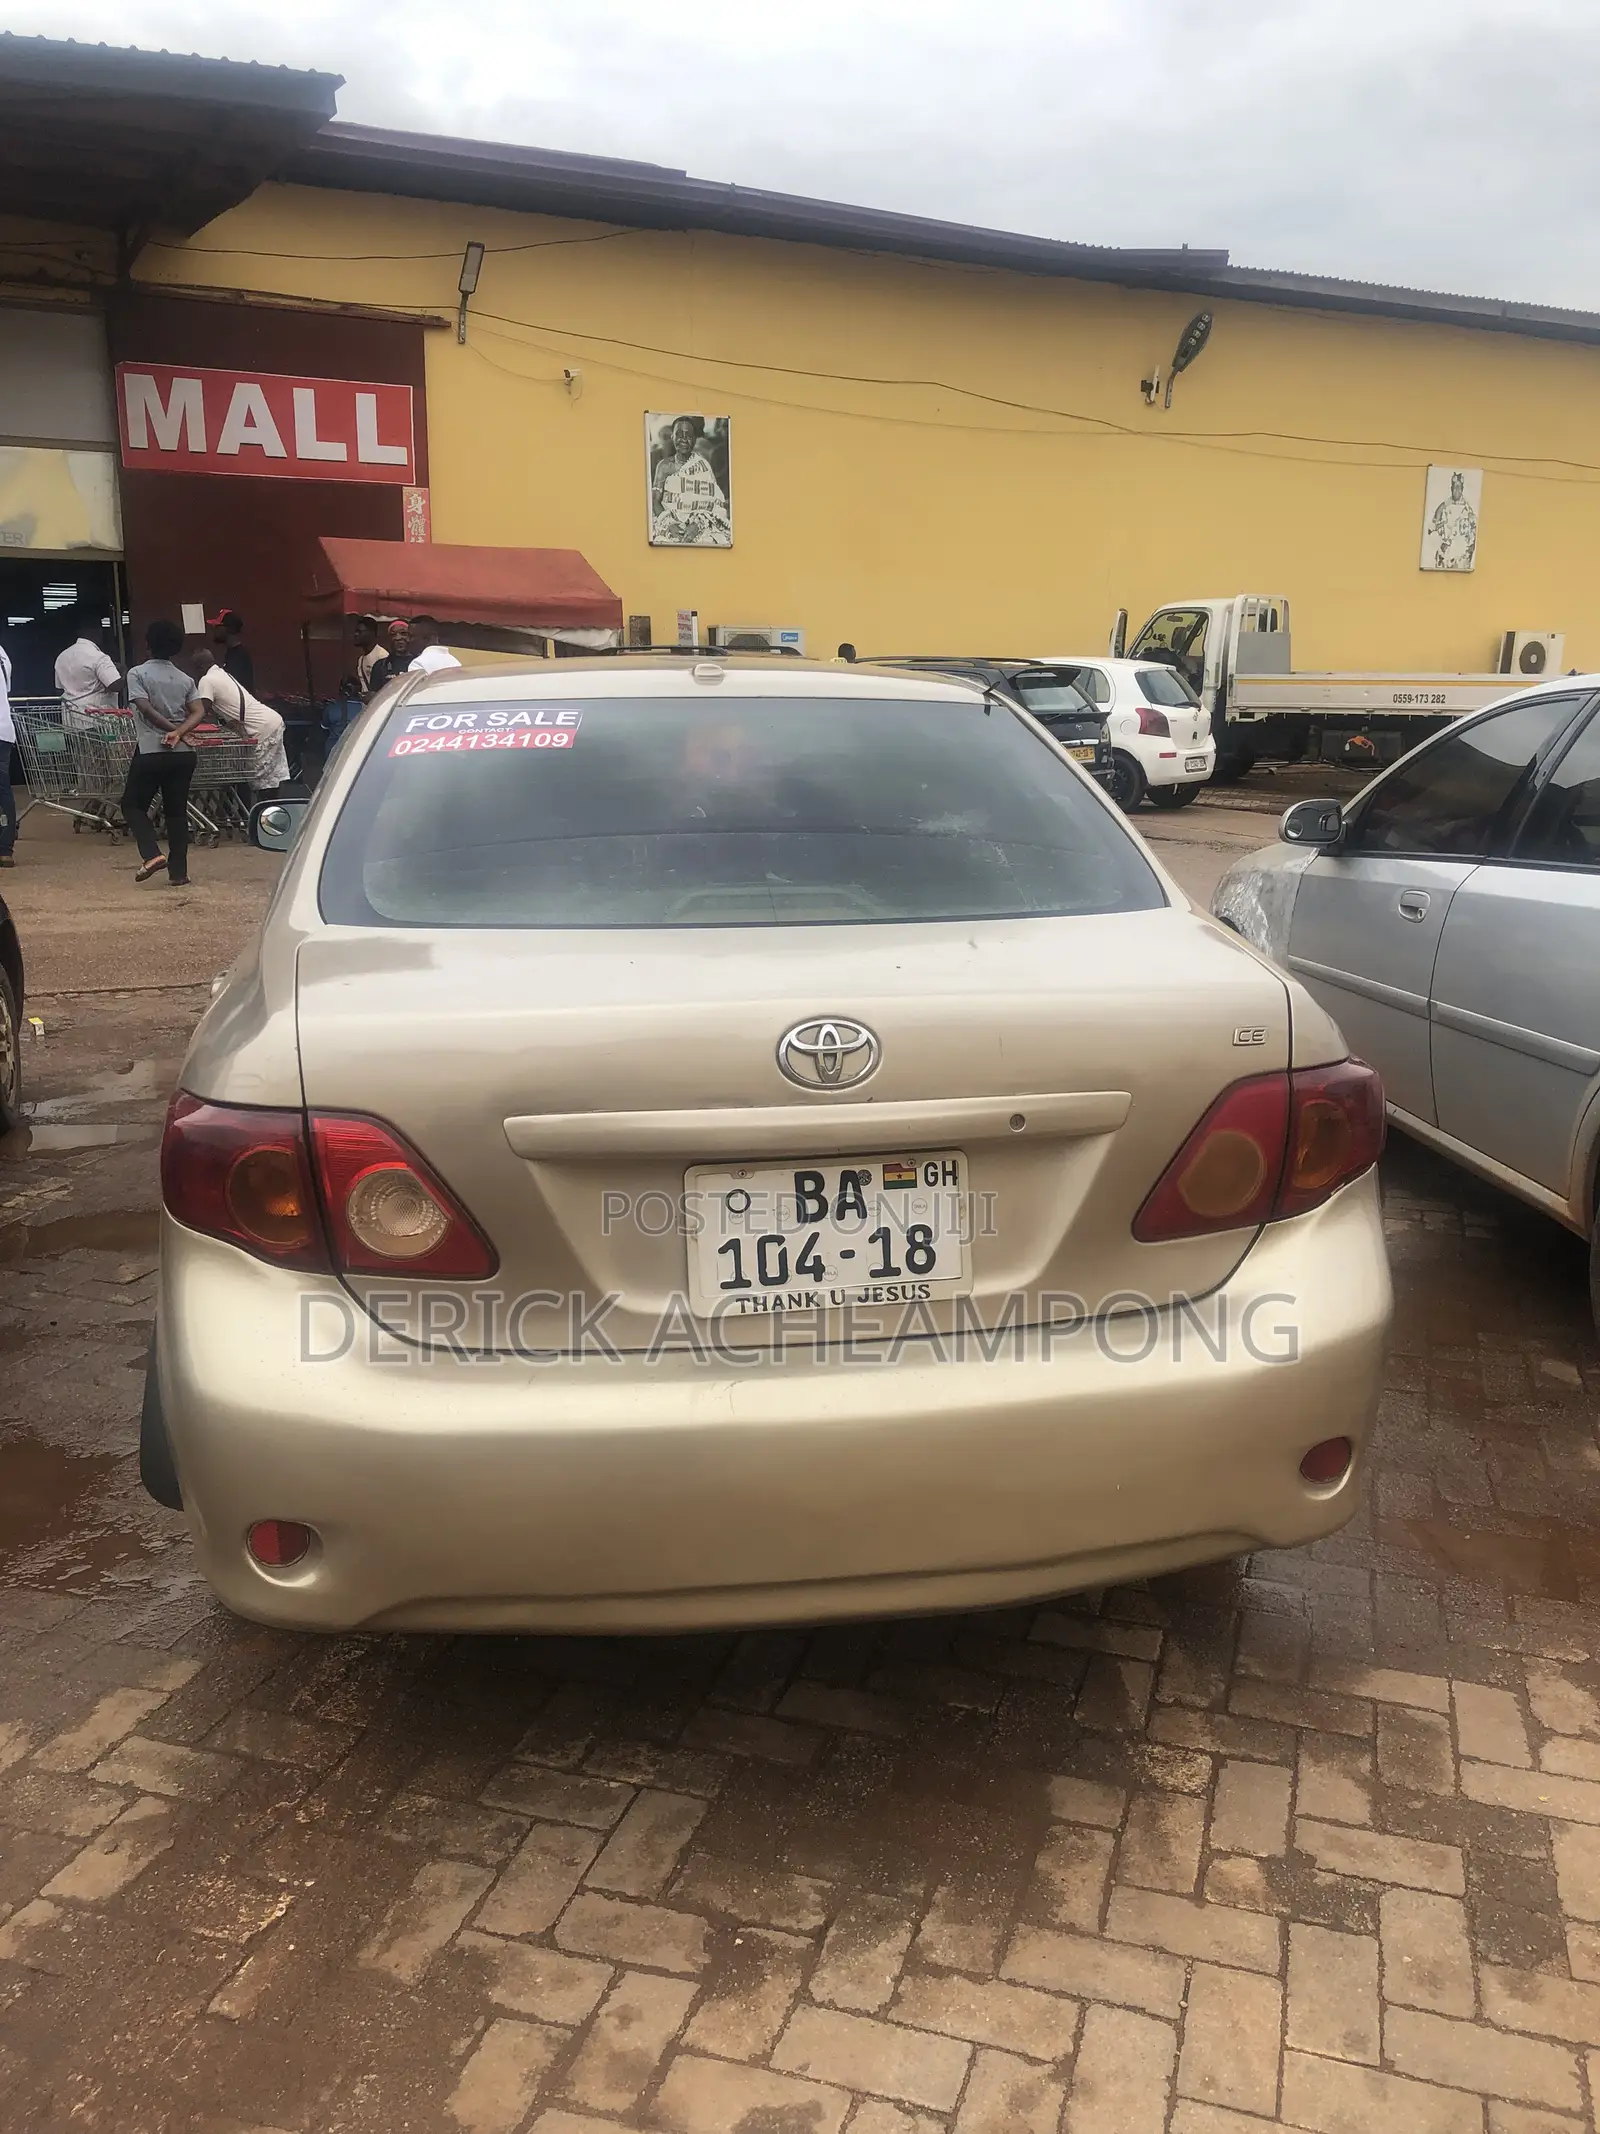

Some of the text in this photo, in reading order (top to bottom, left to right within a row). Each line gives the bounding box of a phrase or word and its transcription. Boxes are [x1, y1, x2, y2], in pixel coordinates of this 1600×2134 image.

[123, 373, 408, 466] MALL
[406, 492, 427, 543] 身體
[1392, 693, 1446, 704] 0559-173 282
[405, 711, 579, 733] FOR SALE
[394, 732, 569, 755] 0244134109
[1238, 1029, 1266, 1042] CE
[793, 1160, 959, 1224] BA GH
[717, 1223, 937, 1290] 104-18
[735, 1283, 932, 1314] THANK U JESUS
